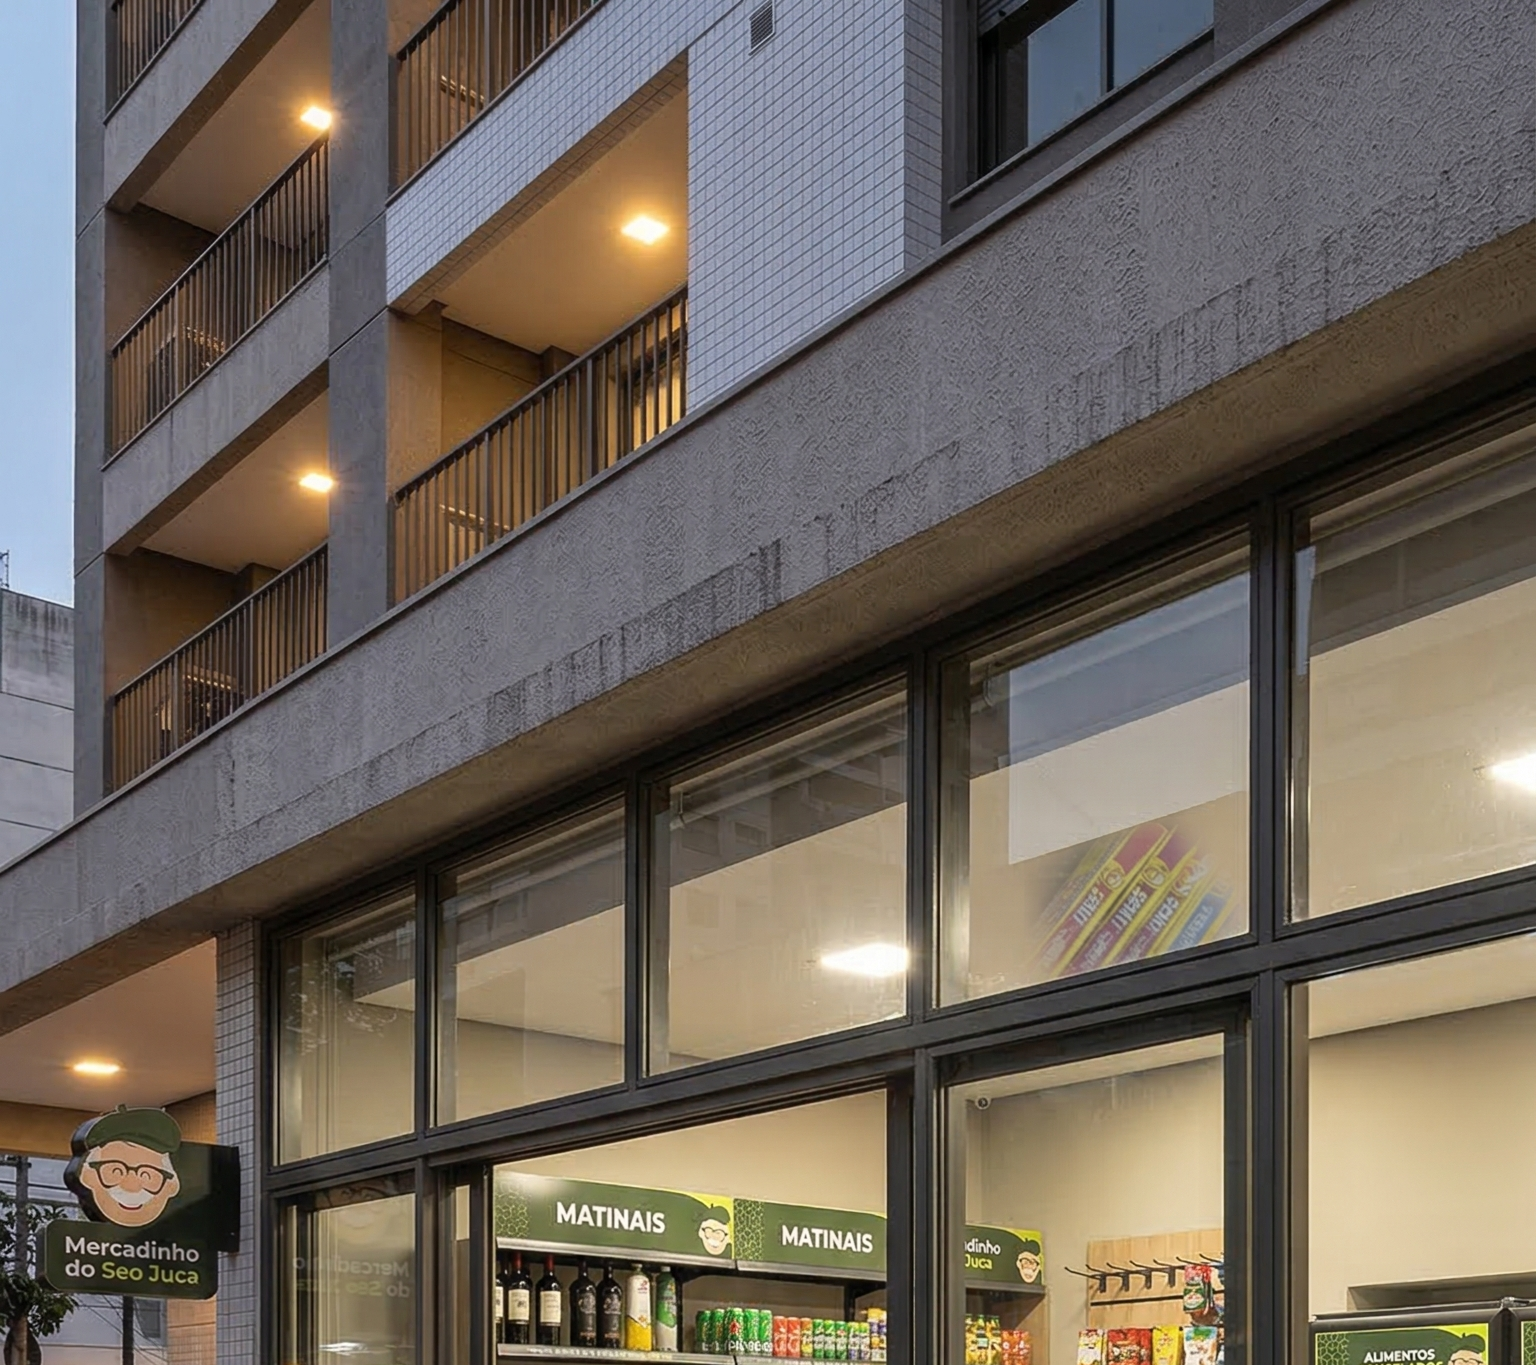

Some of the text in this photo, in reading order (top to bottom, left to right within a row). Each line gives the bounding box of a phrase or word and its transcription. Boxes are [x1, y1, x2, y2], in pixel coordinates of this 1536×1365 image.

[557, 1202, 666, 1234] MATINAIS
[65, 1236, 199, 1262] Mercadinho
[782, 1225, 873, 1253] MATINAIS
[65, 1259, 199, 1284] do Seo Juca
[965, 1254, 993, 1270] Juca
[1364, 1349, 1435, 1363] ALIMENTOS
